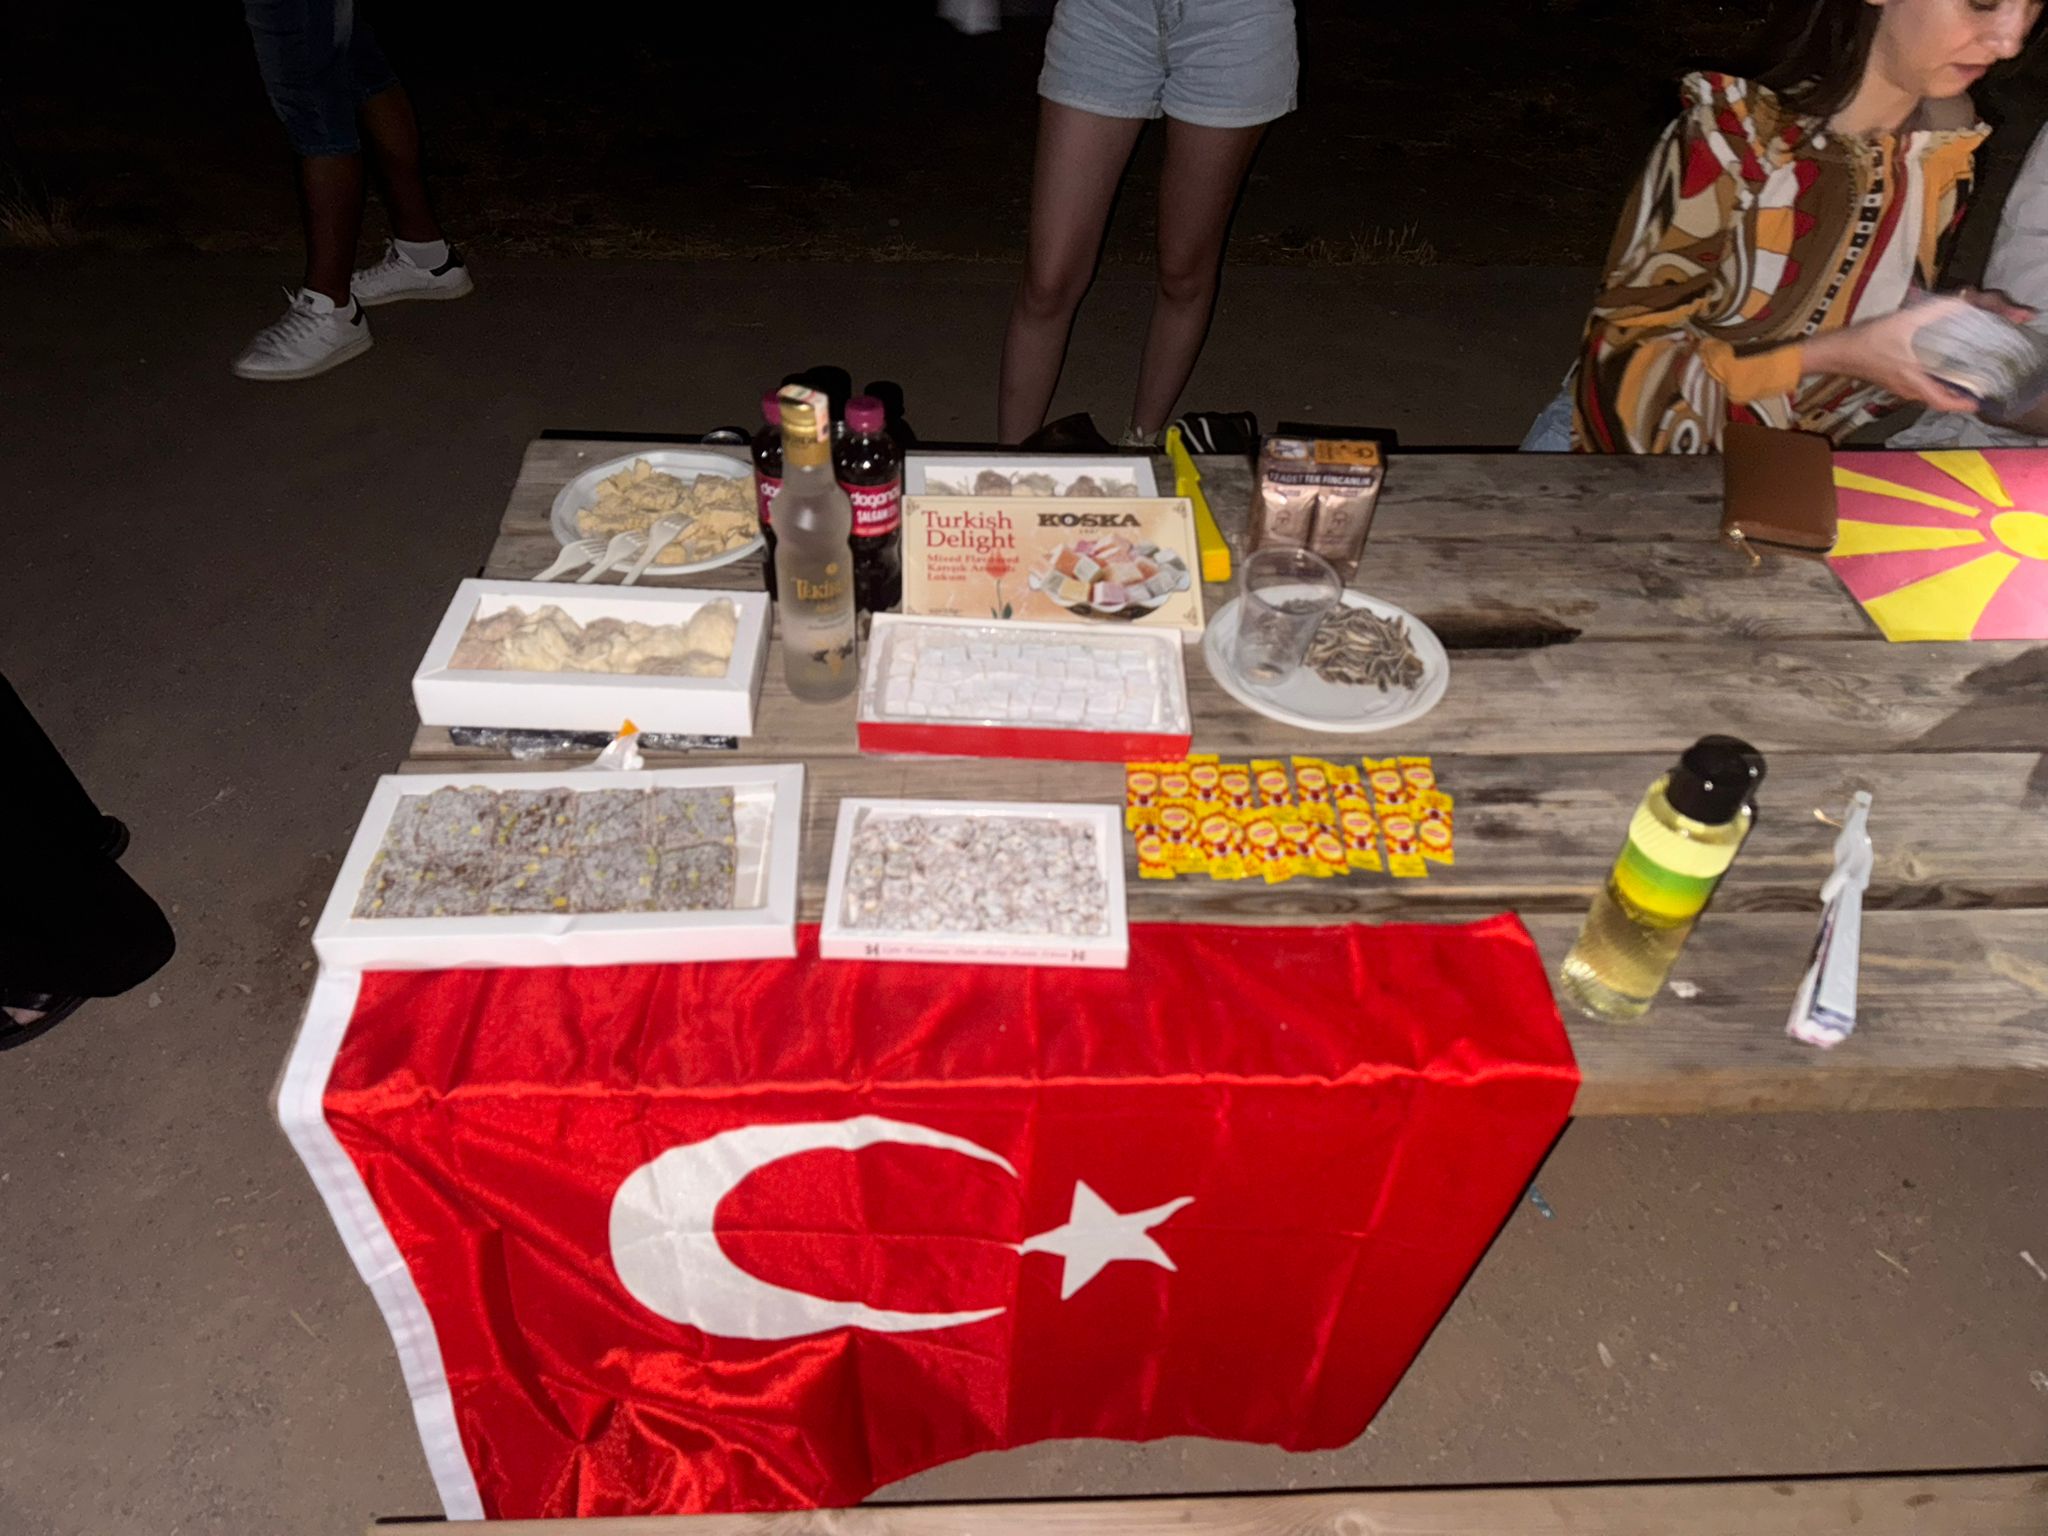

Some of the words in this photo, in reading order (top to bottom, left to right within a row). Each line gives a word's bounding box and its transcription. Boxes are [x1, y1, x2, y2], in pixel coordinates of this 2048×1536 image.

[921, 510, 1012, 530] Turkish
[1037, 513, 1141, 528] KOSKA
[926, 530, 1016, 554] Delight
